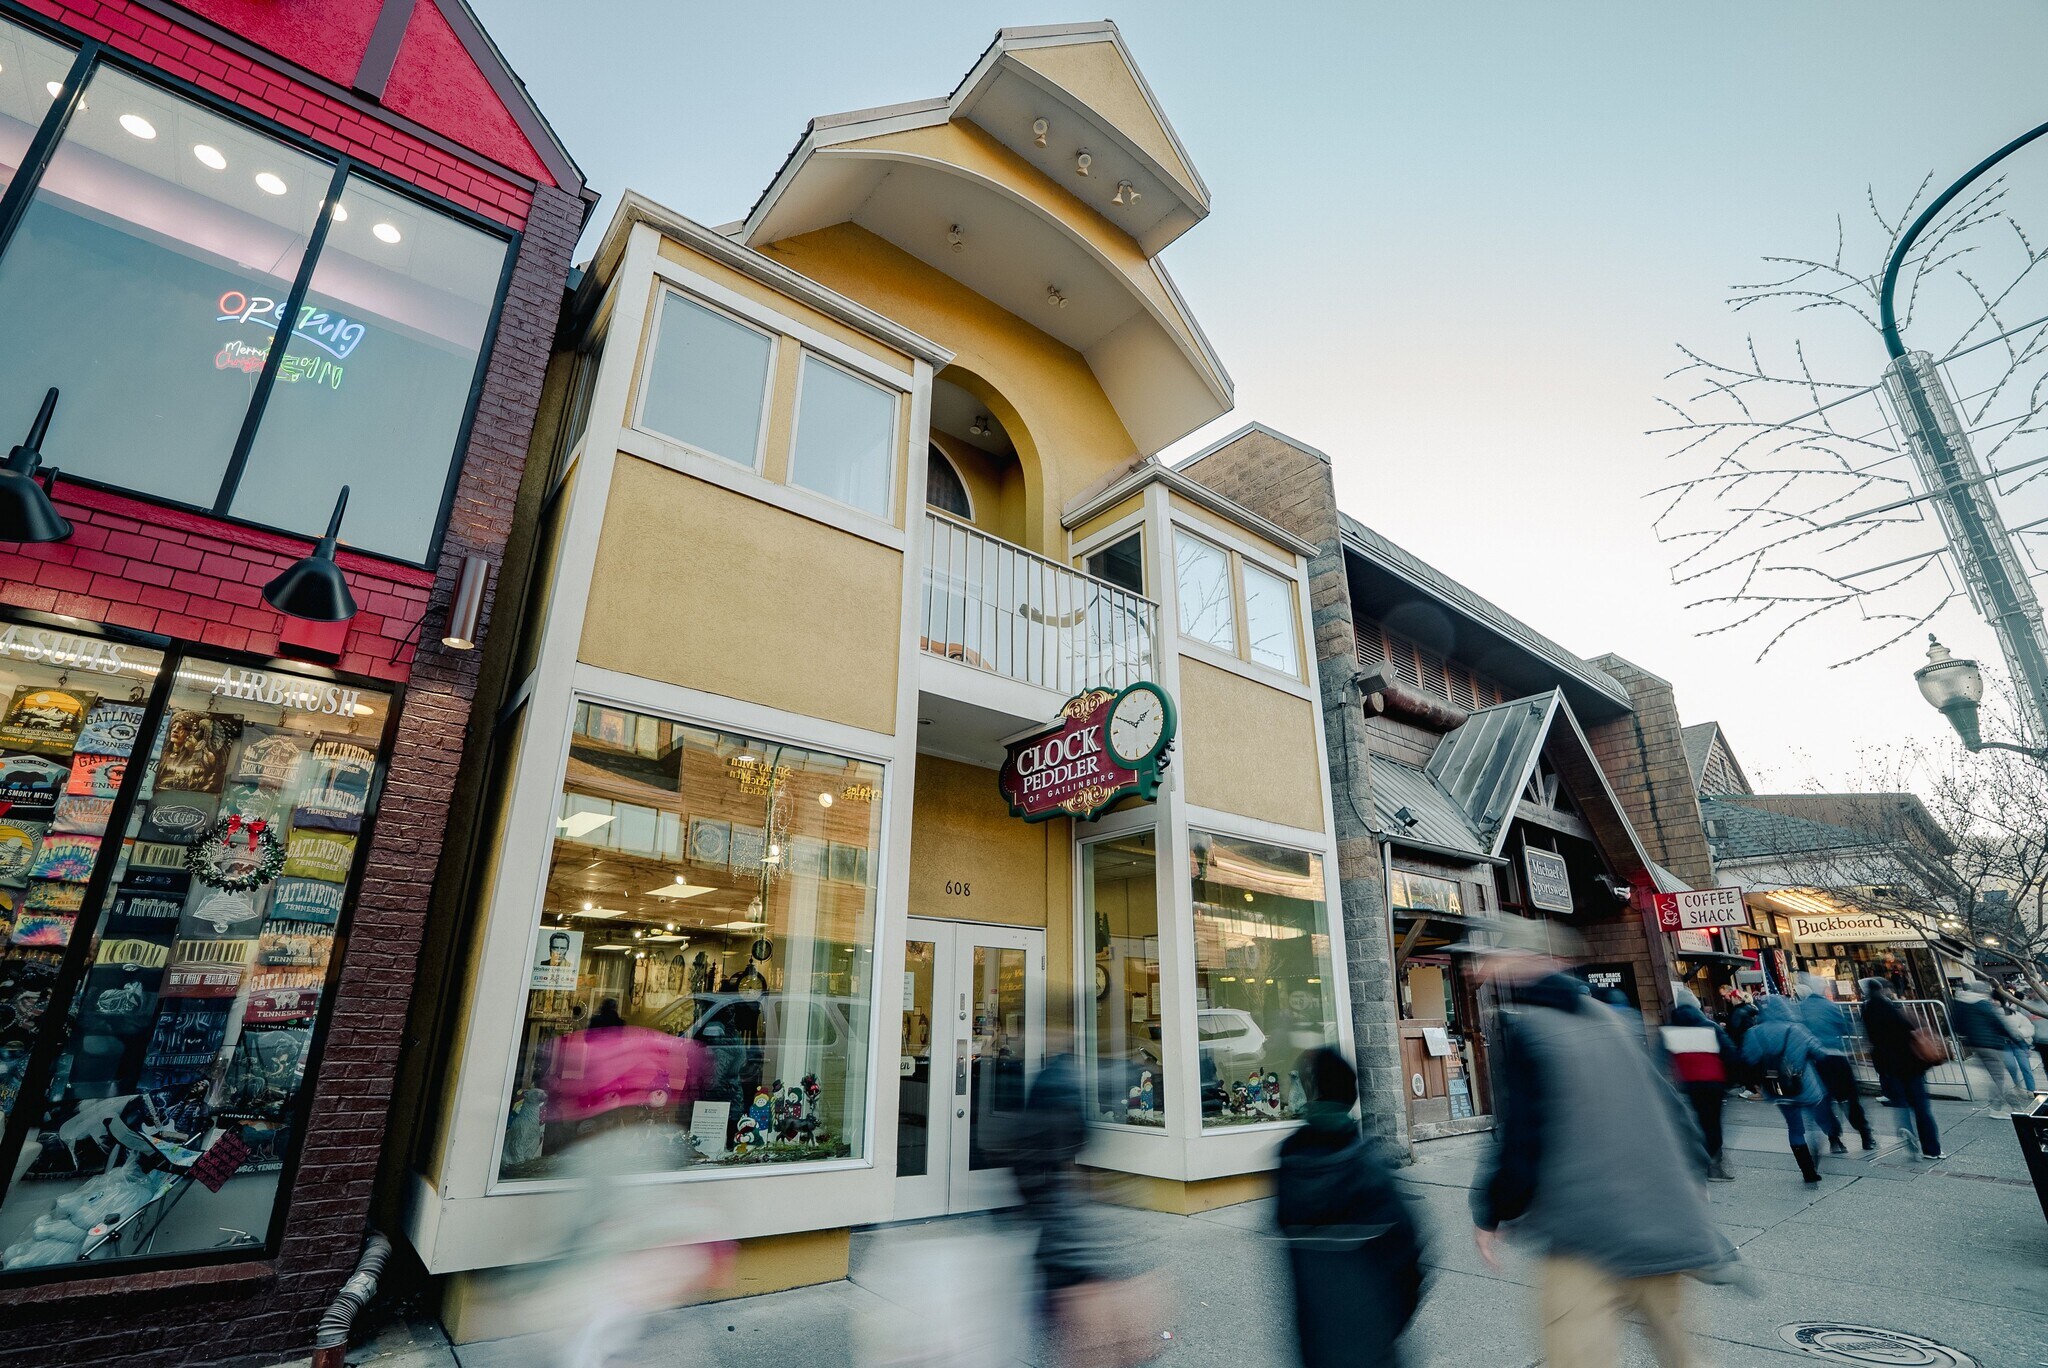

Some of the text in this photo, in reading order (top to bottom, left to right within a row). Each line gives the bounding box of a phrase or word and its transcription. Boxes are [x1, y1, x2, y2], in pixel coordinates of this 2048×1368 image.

[24, 630, 127, 674] SUITS
[211, 667, 361, 718] AIRBRUSH
[85, 711, 143, 726] GATLINB
[88, 737, 134, 751] TENNESS
[1016, 725, 1102, 776] CLOCK
[79, 754, 129, 768] GATLIN
[312, 741, 375, 771] GATLINBURG
[320, 761, 361, 775] TENNESSEE
[1022, 756, 1100, 794] PEDDLER
[8, 789, 33, 798] SMOKY
[34, 792, 54, 801] MTNS.
[1028, 772, 1115, 803] OF GATLINBURG
[297, 788, 361, 816] GATLINBURG
[305, 807, 349, 819] TENNESSEE
[287, 838, 354, 870] GATLINBURG
[295, 858, 340, 872] TENNESSEE
[1530, 859, 1564, 880] Michael's
[945, 879, 971, 897] 608
[1532, 876, 1569, 898] Sportswear
[276, 882, 344, 911] GATLINBURG
[1685, 891, 1735, 908] COFFEE
[285, 903, 331, 915] TENNESSEE
[1690, 908, 1736, 924] SHACK
[262, 920, 336, 936] GATLINBURG
[1795, 914, 1885, 937] Buckboard
[1825, 930, 1880, 938] Nostalgic
[268, 955, 319, 963] TENNESSEE
[257, 1010, 307, 1018] TENNESSEE
